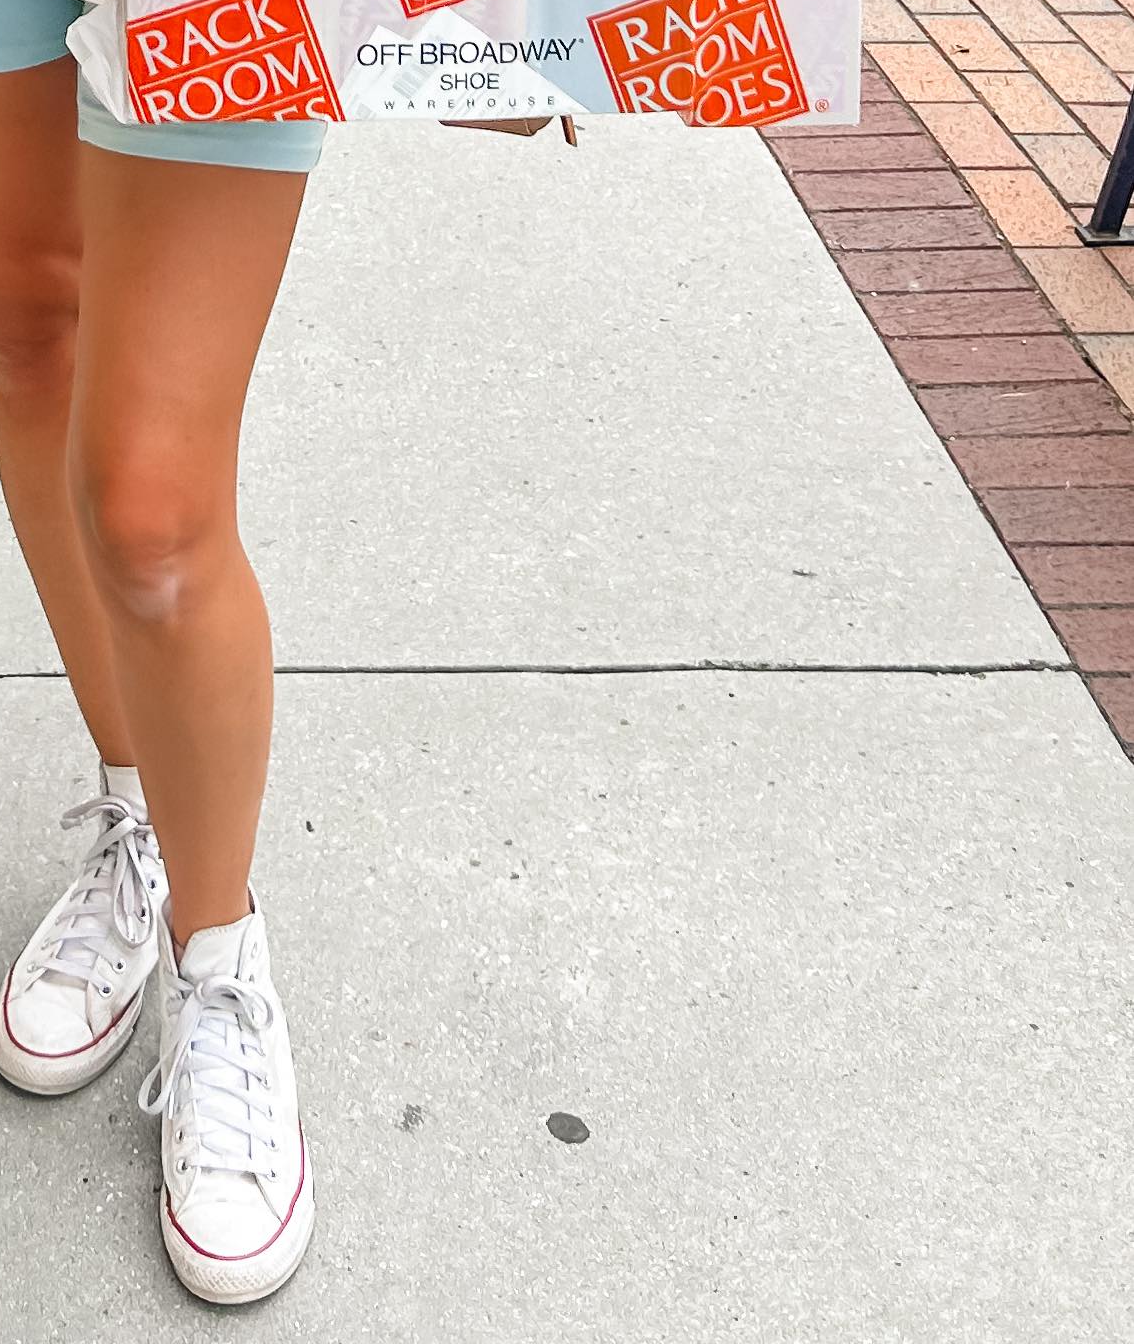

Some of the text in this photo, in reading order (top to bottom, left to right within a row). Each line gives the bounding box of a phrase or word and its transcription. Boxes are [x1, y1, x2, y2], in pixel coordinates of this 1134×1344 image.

[356, 37, 577, 67] OFF BROADWAY
[622, 10, 778, 113] ROOM
[142, 40, 320, 125] ROOM
[383, 95, 555, 110] WAREHOUSE
[439, 72, 501, 91] SHOE
[695, 63, 793, 127] OES
